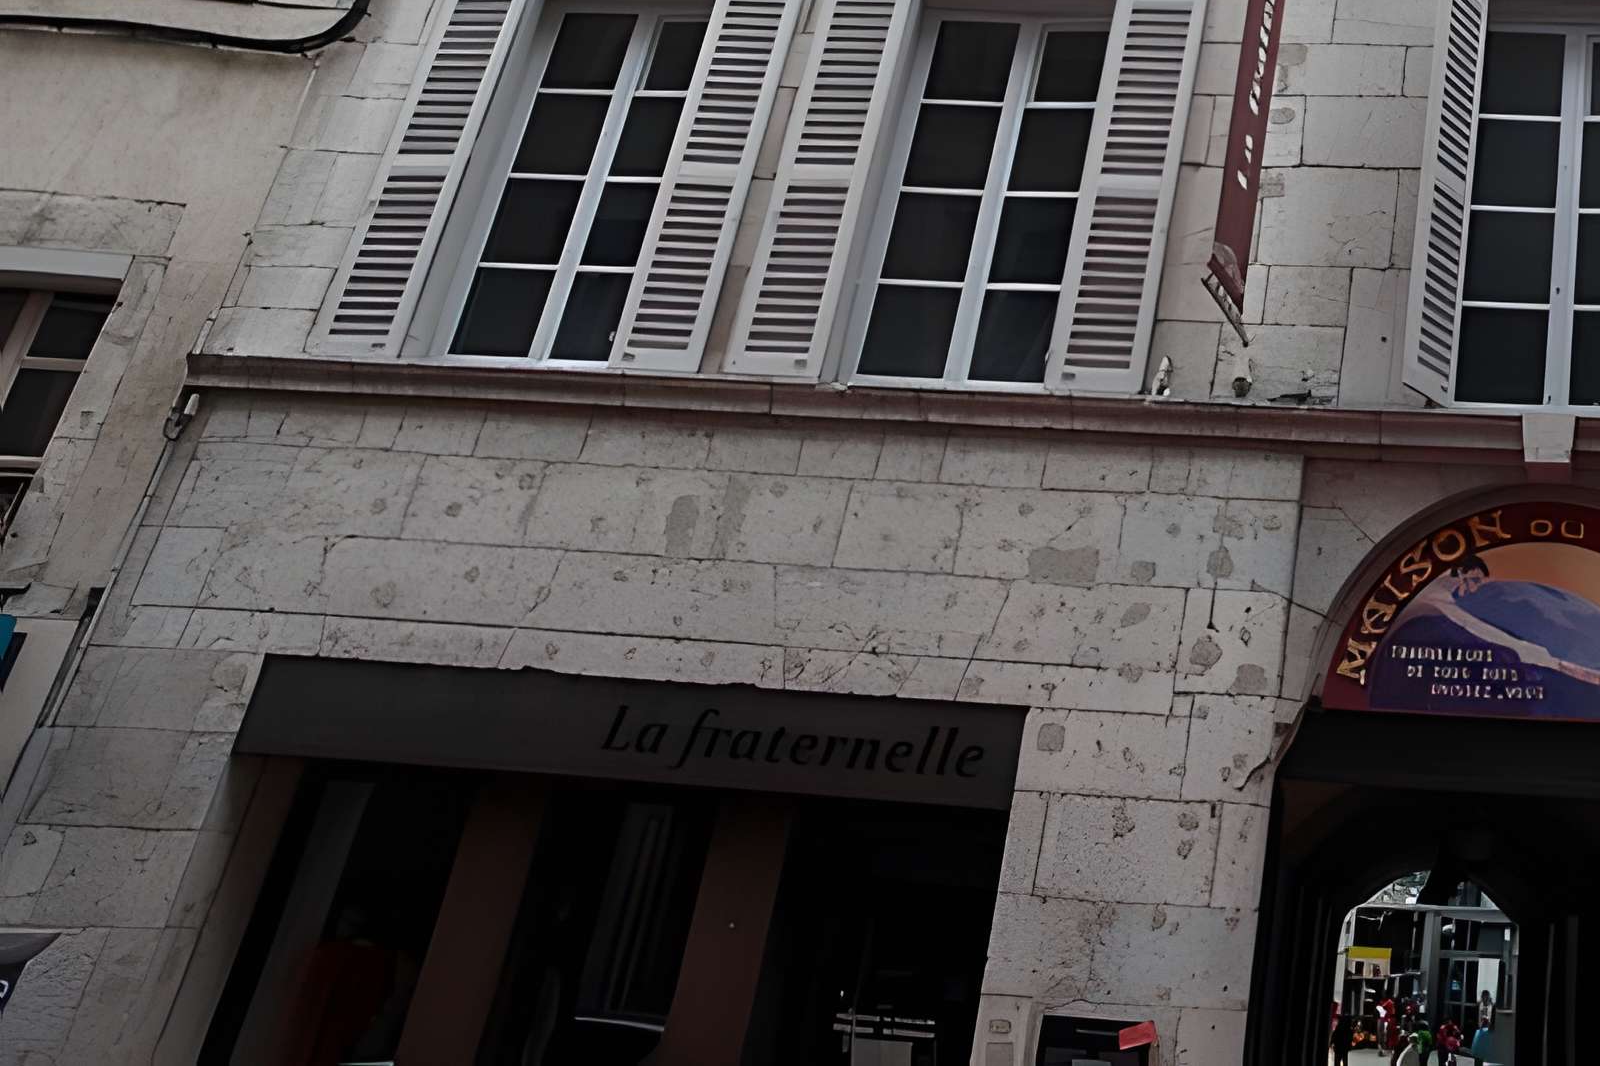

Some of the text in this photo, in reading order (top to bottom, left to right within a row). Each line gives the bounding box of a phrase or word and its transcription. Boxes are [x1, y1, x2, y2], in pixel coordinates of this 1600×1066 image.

[1336, 509, 1511, 686] MAISON
[600, 703, 985, 779] La fraternelle
